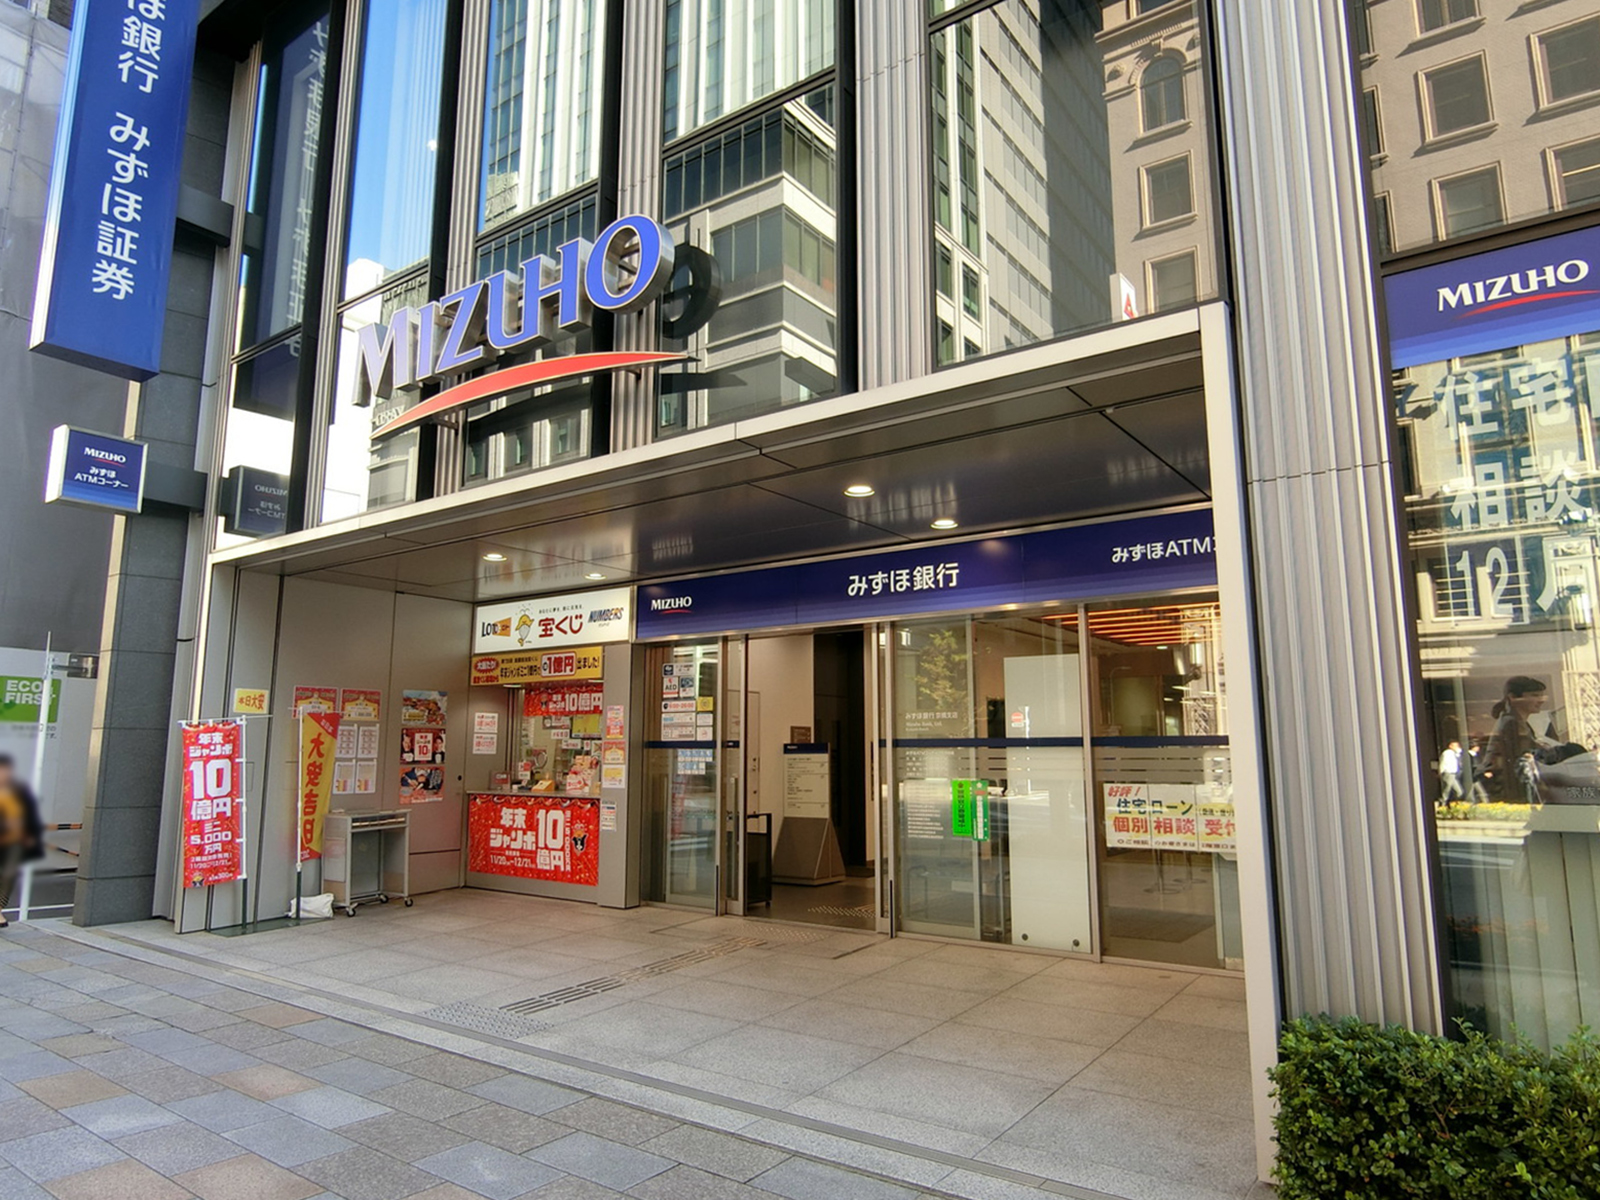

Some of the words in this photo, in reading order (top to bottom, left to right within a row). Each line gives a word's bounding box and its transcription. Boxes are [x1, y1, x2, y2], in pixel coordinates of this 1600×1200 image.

[91, 111, 151, 300] みずほ証券
[1436, 259, 1590, 312] MIZUHO
[352, 213, 674, 407] MIZUHO
[1440, 355, 1600, 441] 住宅
[84, 446, 126, 464] MIZUHO
[74, 472, 130, 489] ATMコーナー
[89, 466, 117, 478] みずほ
[1111, 536, 1216, 563] みずほATM
[847, 562, 960, 597] みずほ銀行
[587, 607, 625, 623] NUMBERS
[651, 596, 692, 611] MIZUHO
[538, 614, 583, 638] 宝くじ
[6, 680, 43, 692] ECO
[198, 733, 224, 745] 年末
[189, 744, 233, 758] ジャンボ
[190, 758, 232, 800] 10
[190, 797, 232, 821] 億円
[501, 807, 527, 829] 年末
[1116, 798, 1193, 815] 住宅ローン
[204, 821, 222, 833] ミニ
[537, 809, 565, 850] 10
[489, 828, 537, 851] ジャンボ
[537, 848, 565, 872] 億円
